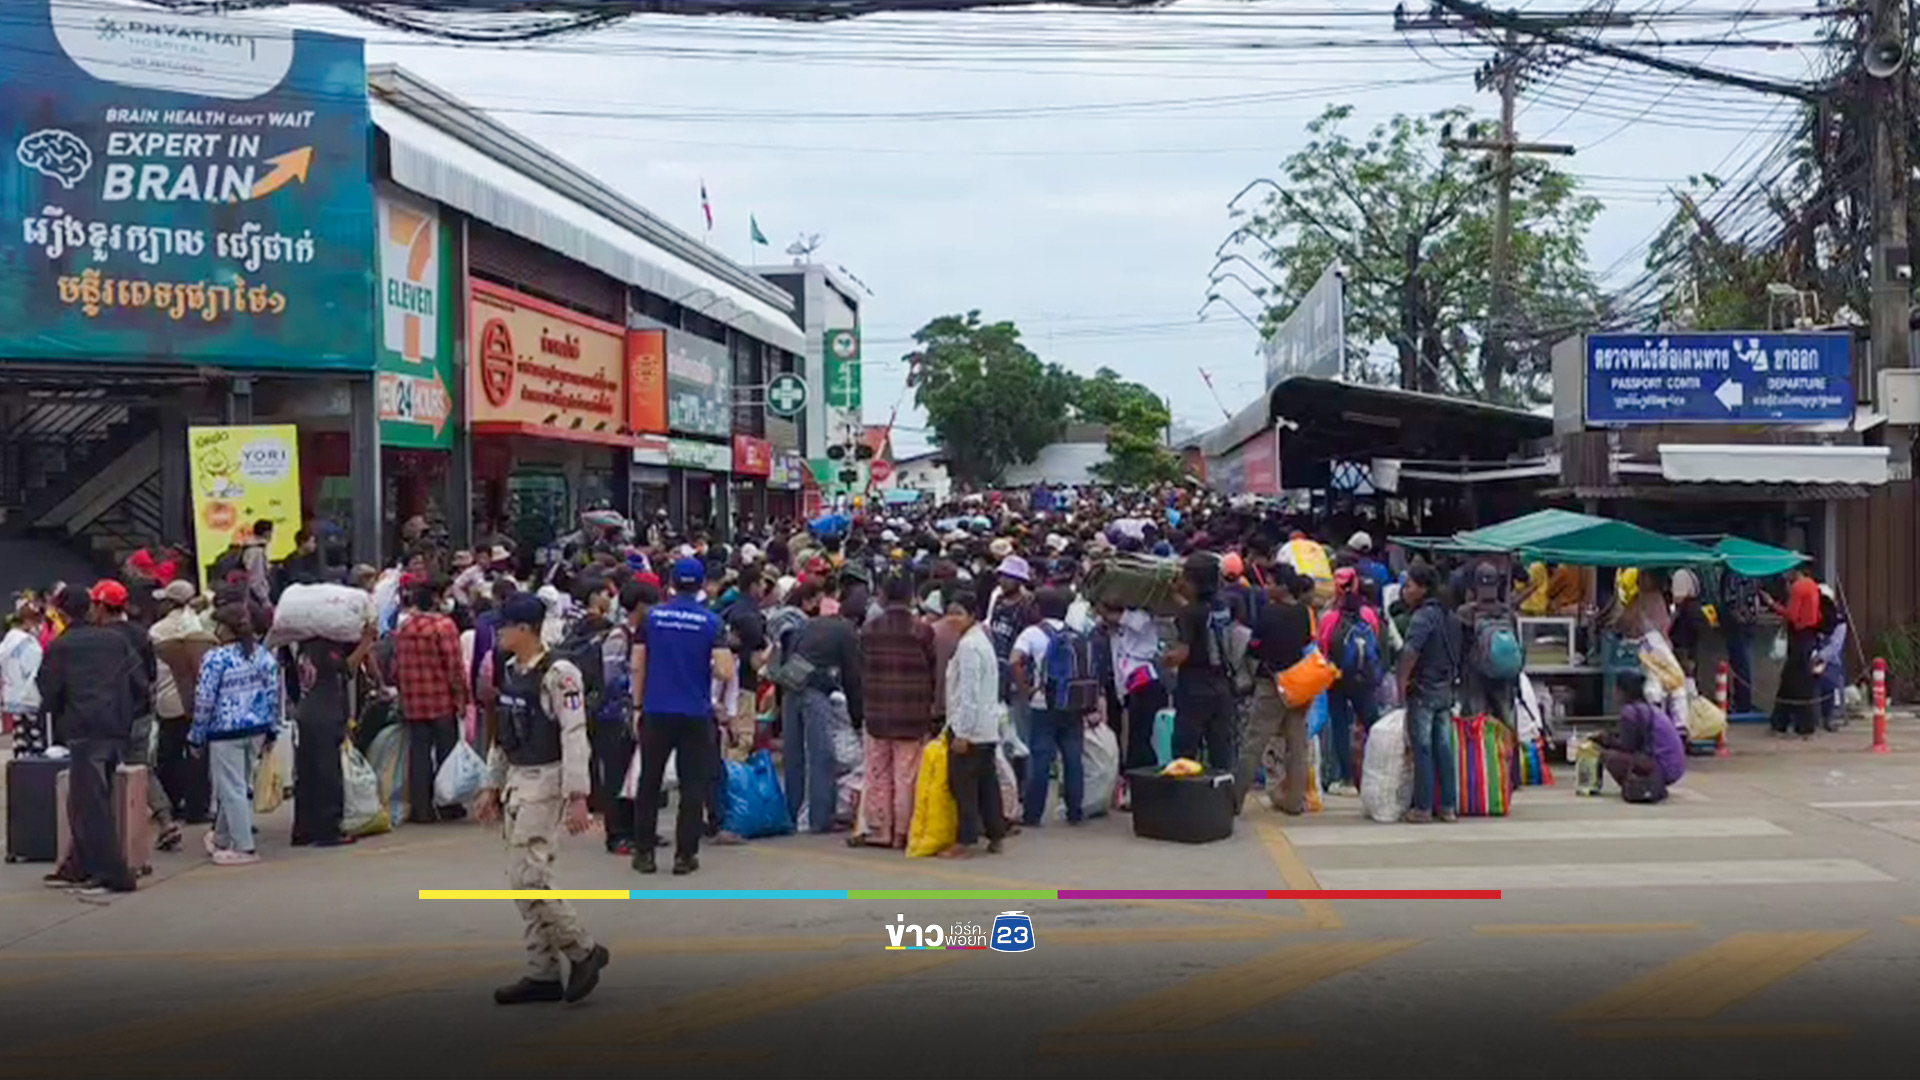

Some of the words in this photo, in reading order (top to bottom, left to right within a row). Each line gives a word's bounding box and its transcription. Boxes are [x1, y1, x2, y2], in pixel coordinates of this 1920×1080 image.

[106, 108, 158, 124] BRAIN
[163, 109, 225, 126] HEALTH
[268, 111, 314, 128] WAIT
[106, 132, 221, 157] EXPERT
[228, 135, 260, 158] IN
[102, 163, 255, 202] BRAIN
[1611, 377, 1662, 390] PASSPORT
[1767, 377, 1826, 390] DEPARTURE
[244, 450, 286, 461] YORI
